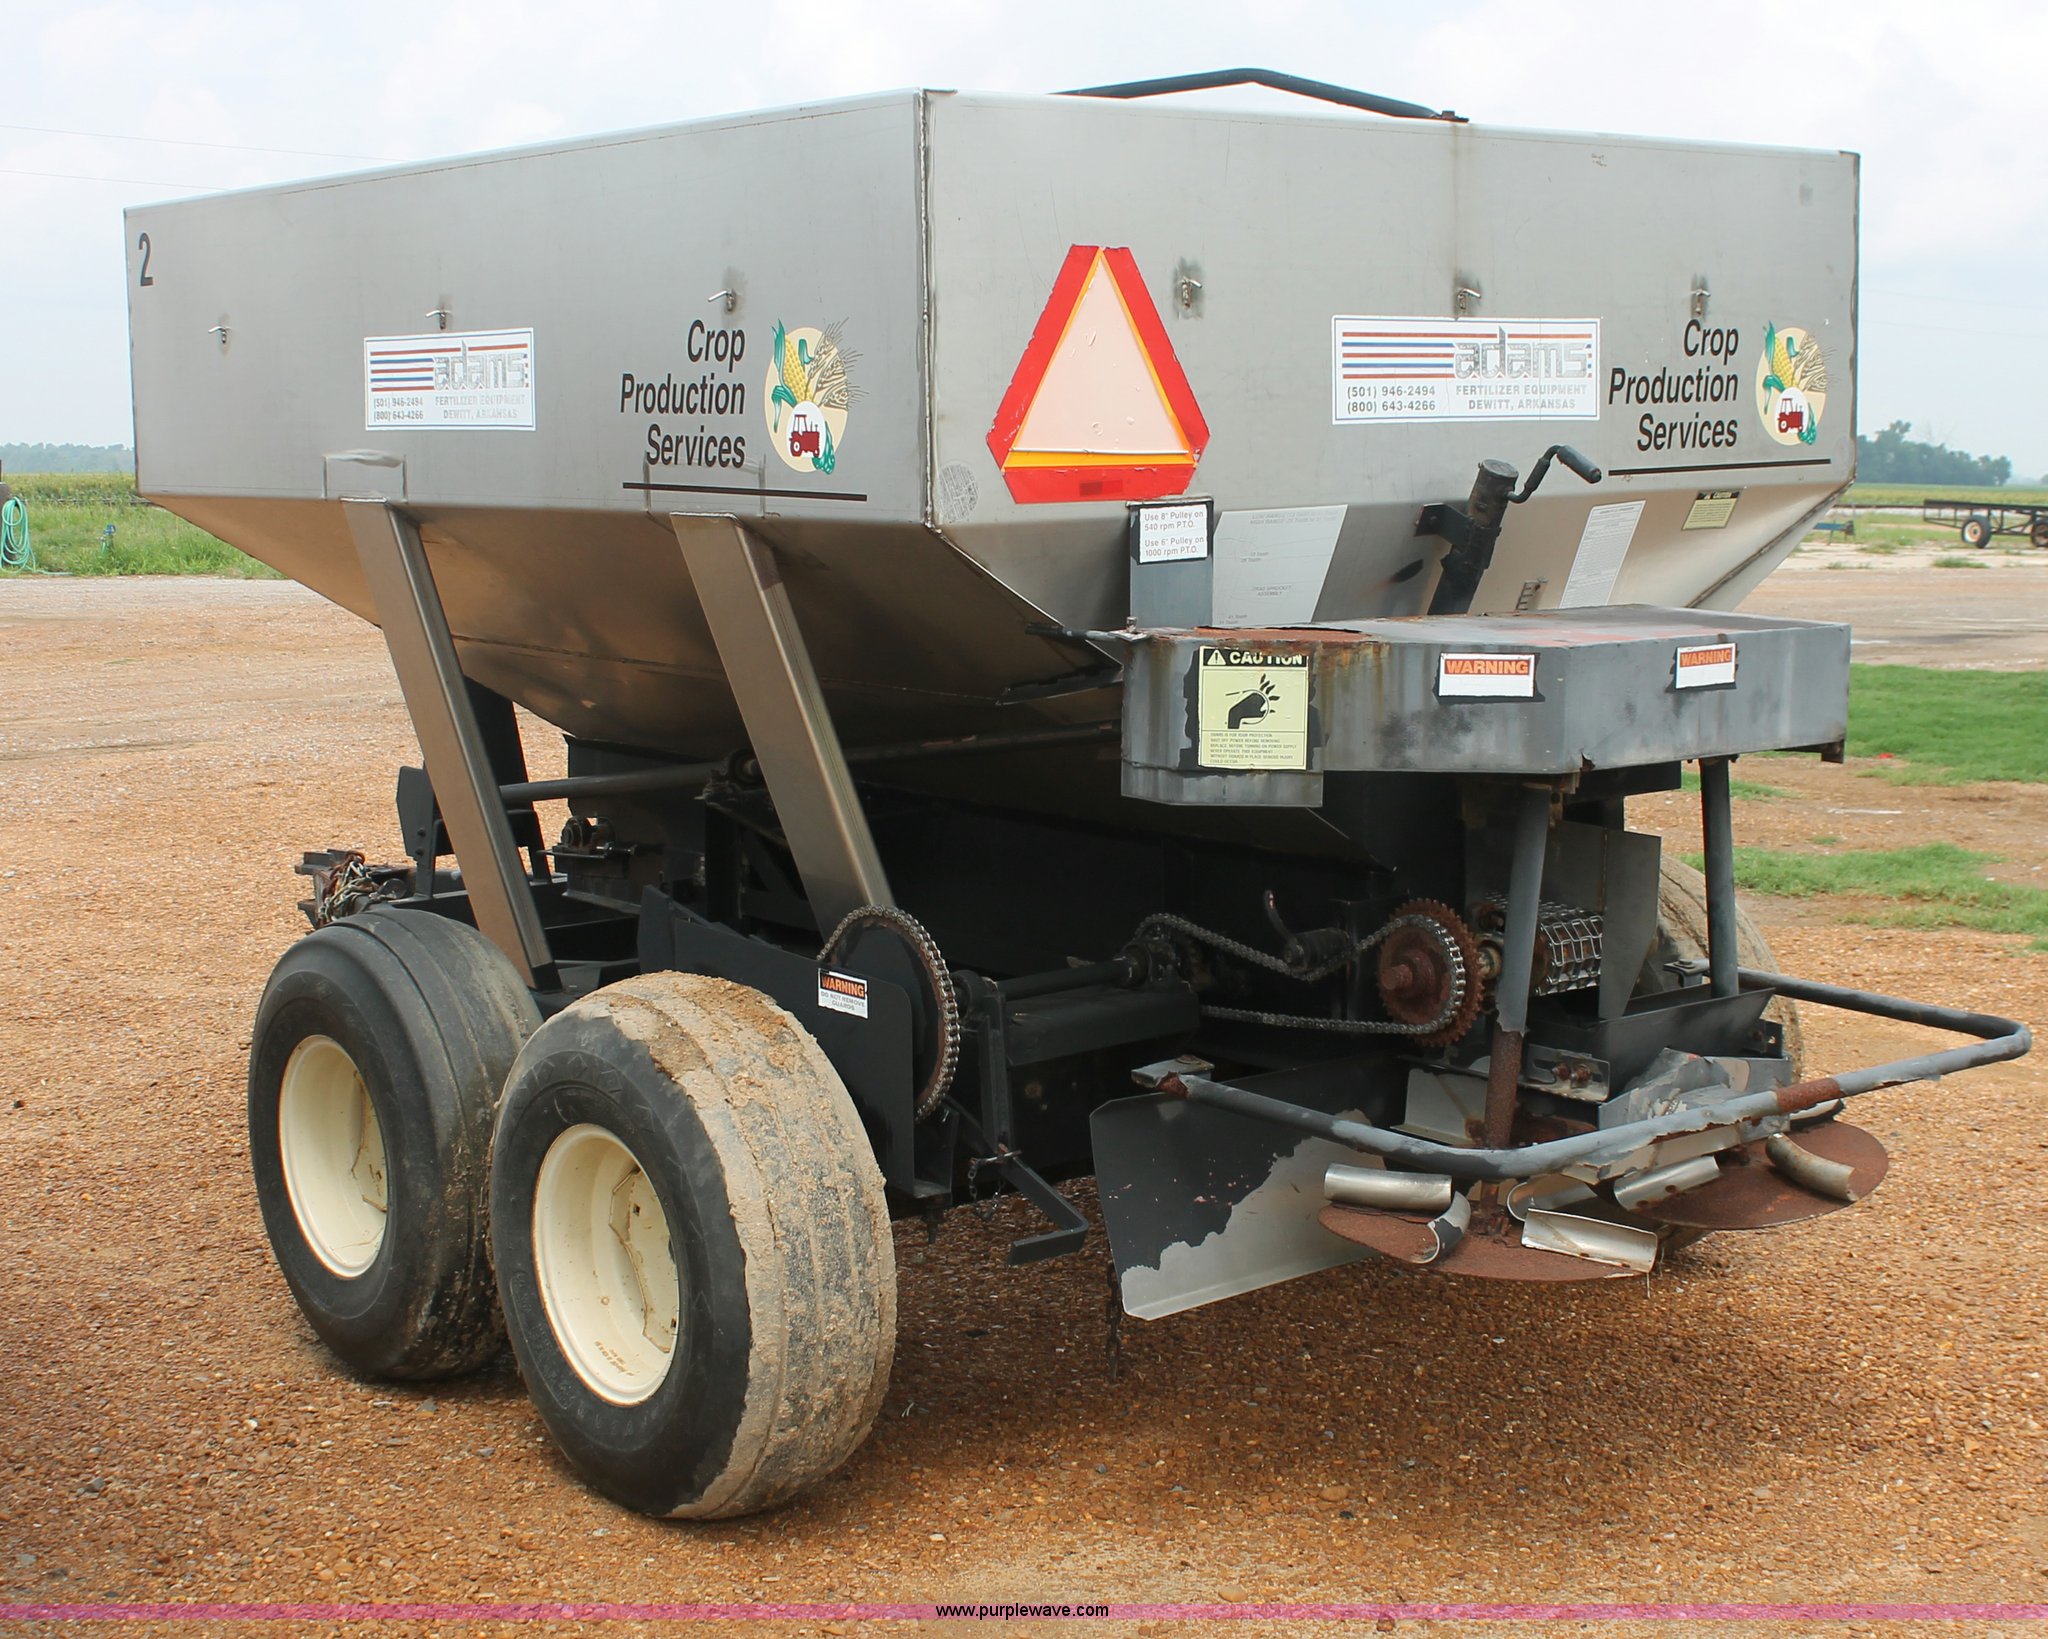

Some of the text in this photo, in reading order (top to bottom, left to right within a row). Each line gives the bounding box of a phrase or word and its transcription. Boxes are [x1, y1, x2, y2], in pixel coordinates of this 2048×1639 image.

[138, 232, 154, 287] 2
[687, 319, 746, 373] Crop
[1683, 318, 1740, 366] Crop
[1346, 385, 1436, 399] (501) 946-2494
[1456, 384, 1588, 396] FERTILIZER EQUIPMENT
[1608, 365, 1739, 405] Production
[435, 393, 526, 406] FERTILIZER EQUIPMENT
[620, 373, 746, 415] Production
[373, 397, 391, 410] (501)
[1346, 400, 1436, 414] (800) 643-4266
[1468, 399, 1576, 411] DEWITT, ARKANSAS
[373, 410, 424, 422] (800) 643-4266
[476, 408, 518, 419] ARKANSAS
[1636, 412, 1738, 452] Services
[646, 423, 746, 469] Services
[1144, 513, 1159, 521] Use
[1170, 511, 1193, 519] Pulley
[1144, 523, 1158, 531] 540
[1160, 523, 1175, 532] rpm
[1144, 539, 1159, 547] Use
[1170, 537, 1193, 546] Pulley
[1145, 548, 1162, 557] 1000
[1163, 548, 1178, 557] rpm
[1681, 648, 1731, 667] WARNING
[1446, 660, 1529, 674] WARNING
[822, 975, 865, 997] WARNING
